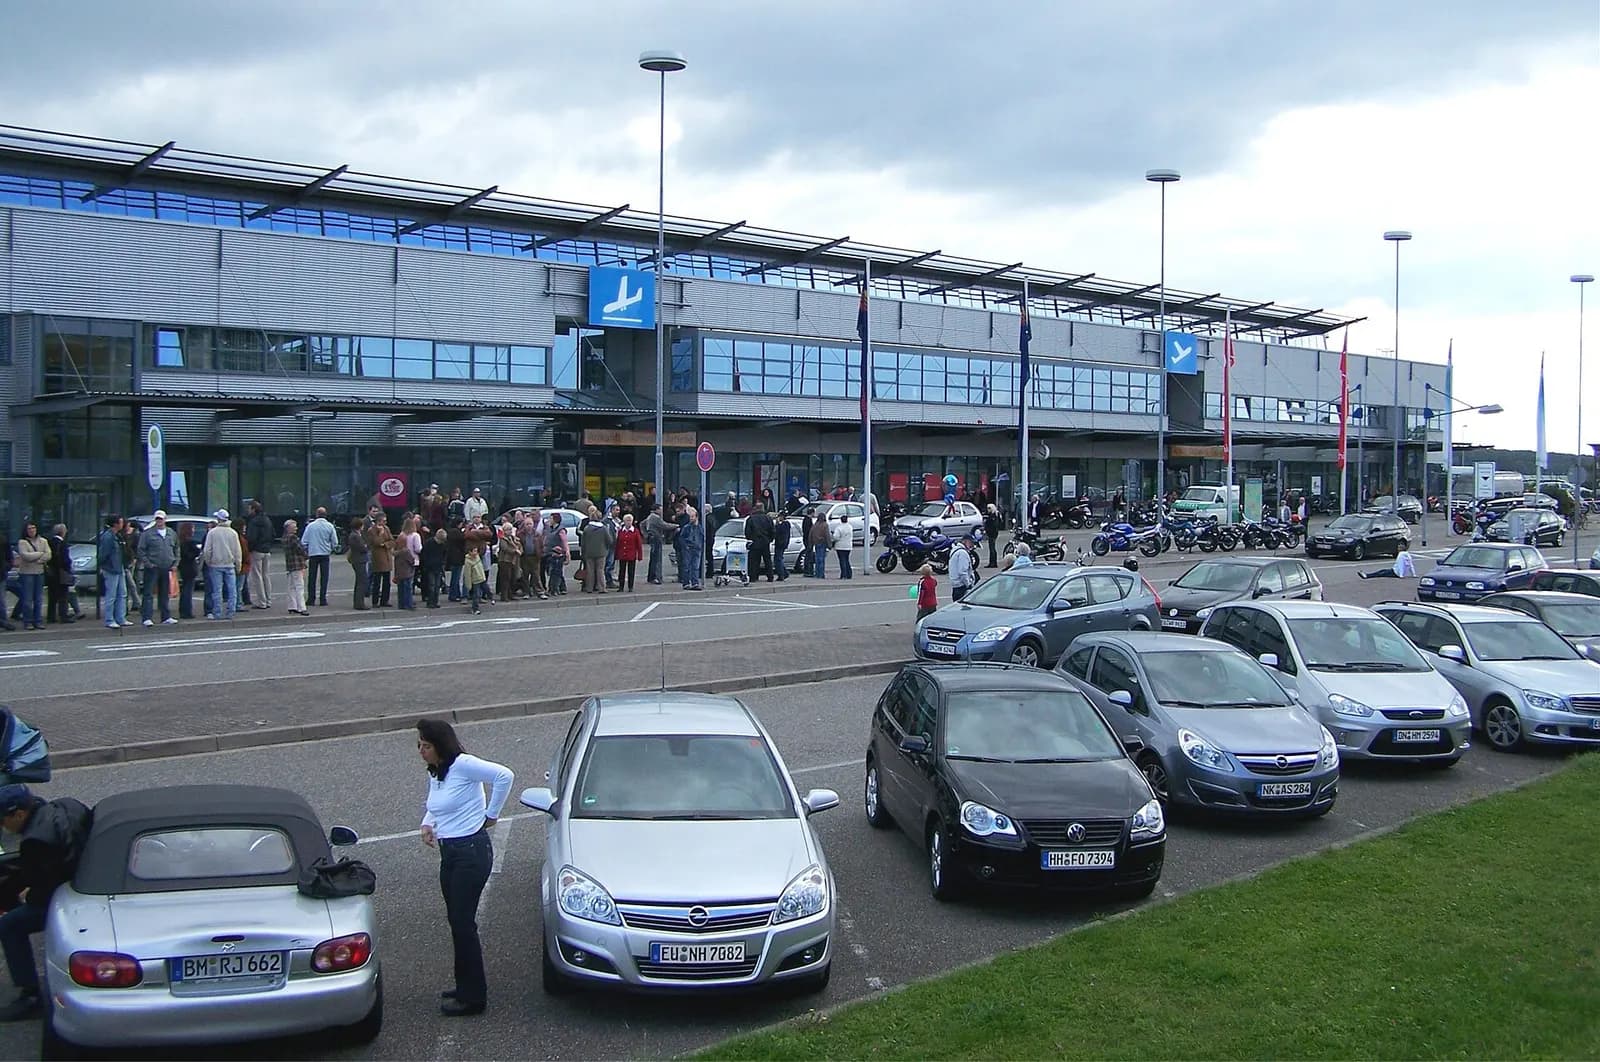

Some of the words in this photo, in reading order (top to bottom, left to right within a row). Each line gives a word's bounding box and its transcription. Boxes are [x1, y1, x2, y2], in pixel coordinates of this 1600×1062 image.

[1263, 785, 1275, 795] NK
[1281, 784, 1293, 794] AS
[1294, 783, 1310, 793] 284
[1049, 853, 1064, 866] HH
[1071, 853, 1085, 865] FO
[1087, 852, 1113, 865] 7394
[661, 946, 679, 960] EU
[689, 946, 707, 961] NH
[710, 946, 743, 961] 7082
[184, 957, 208, 977] BM
[220, 956, 243, 975] RJ
[248, 954, 281, 972] 662
